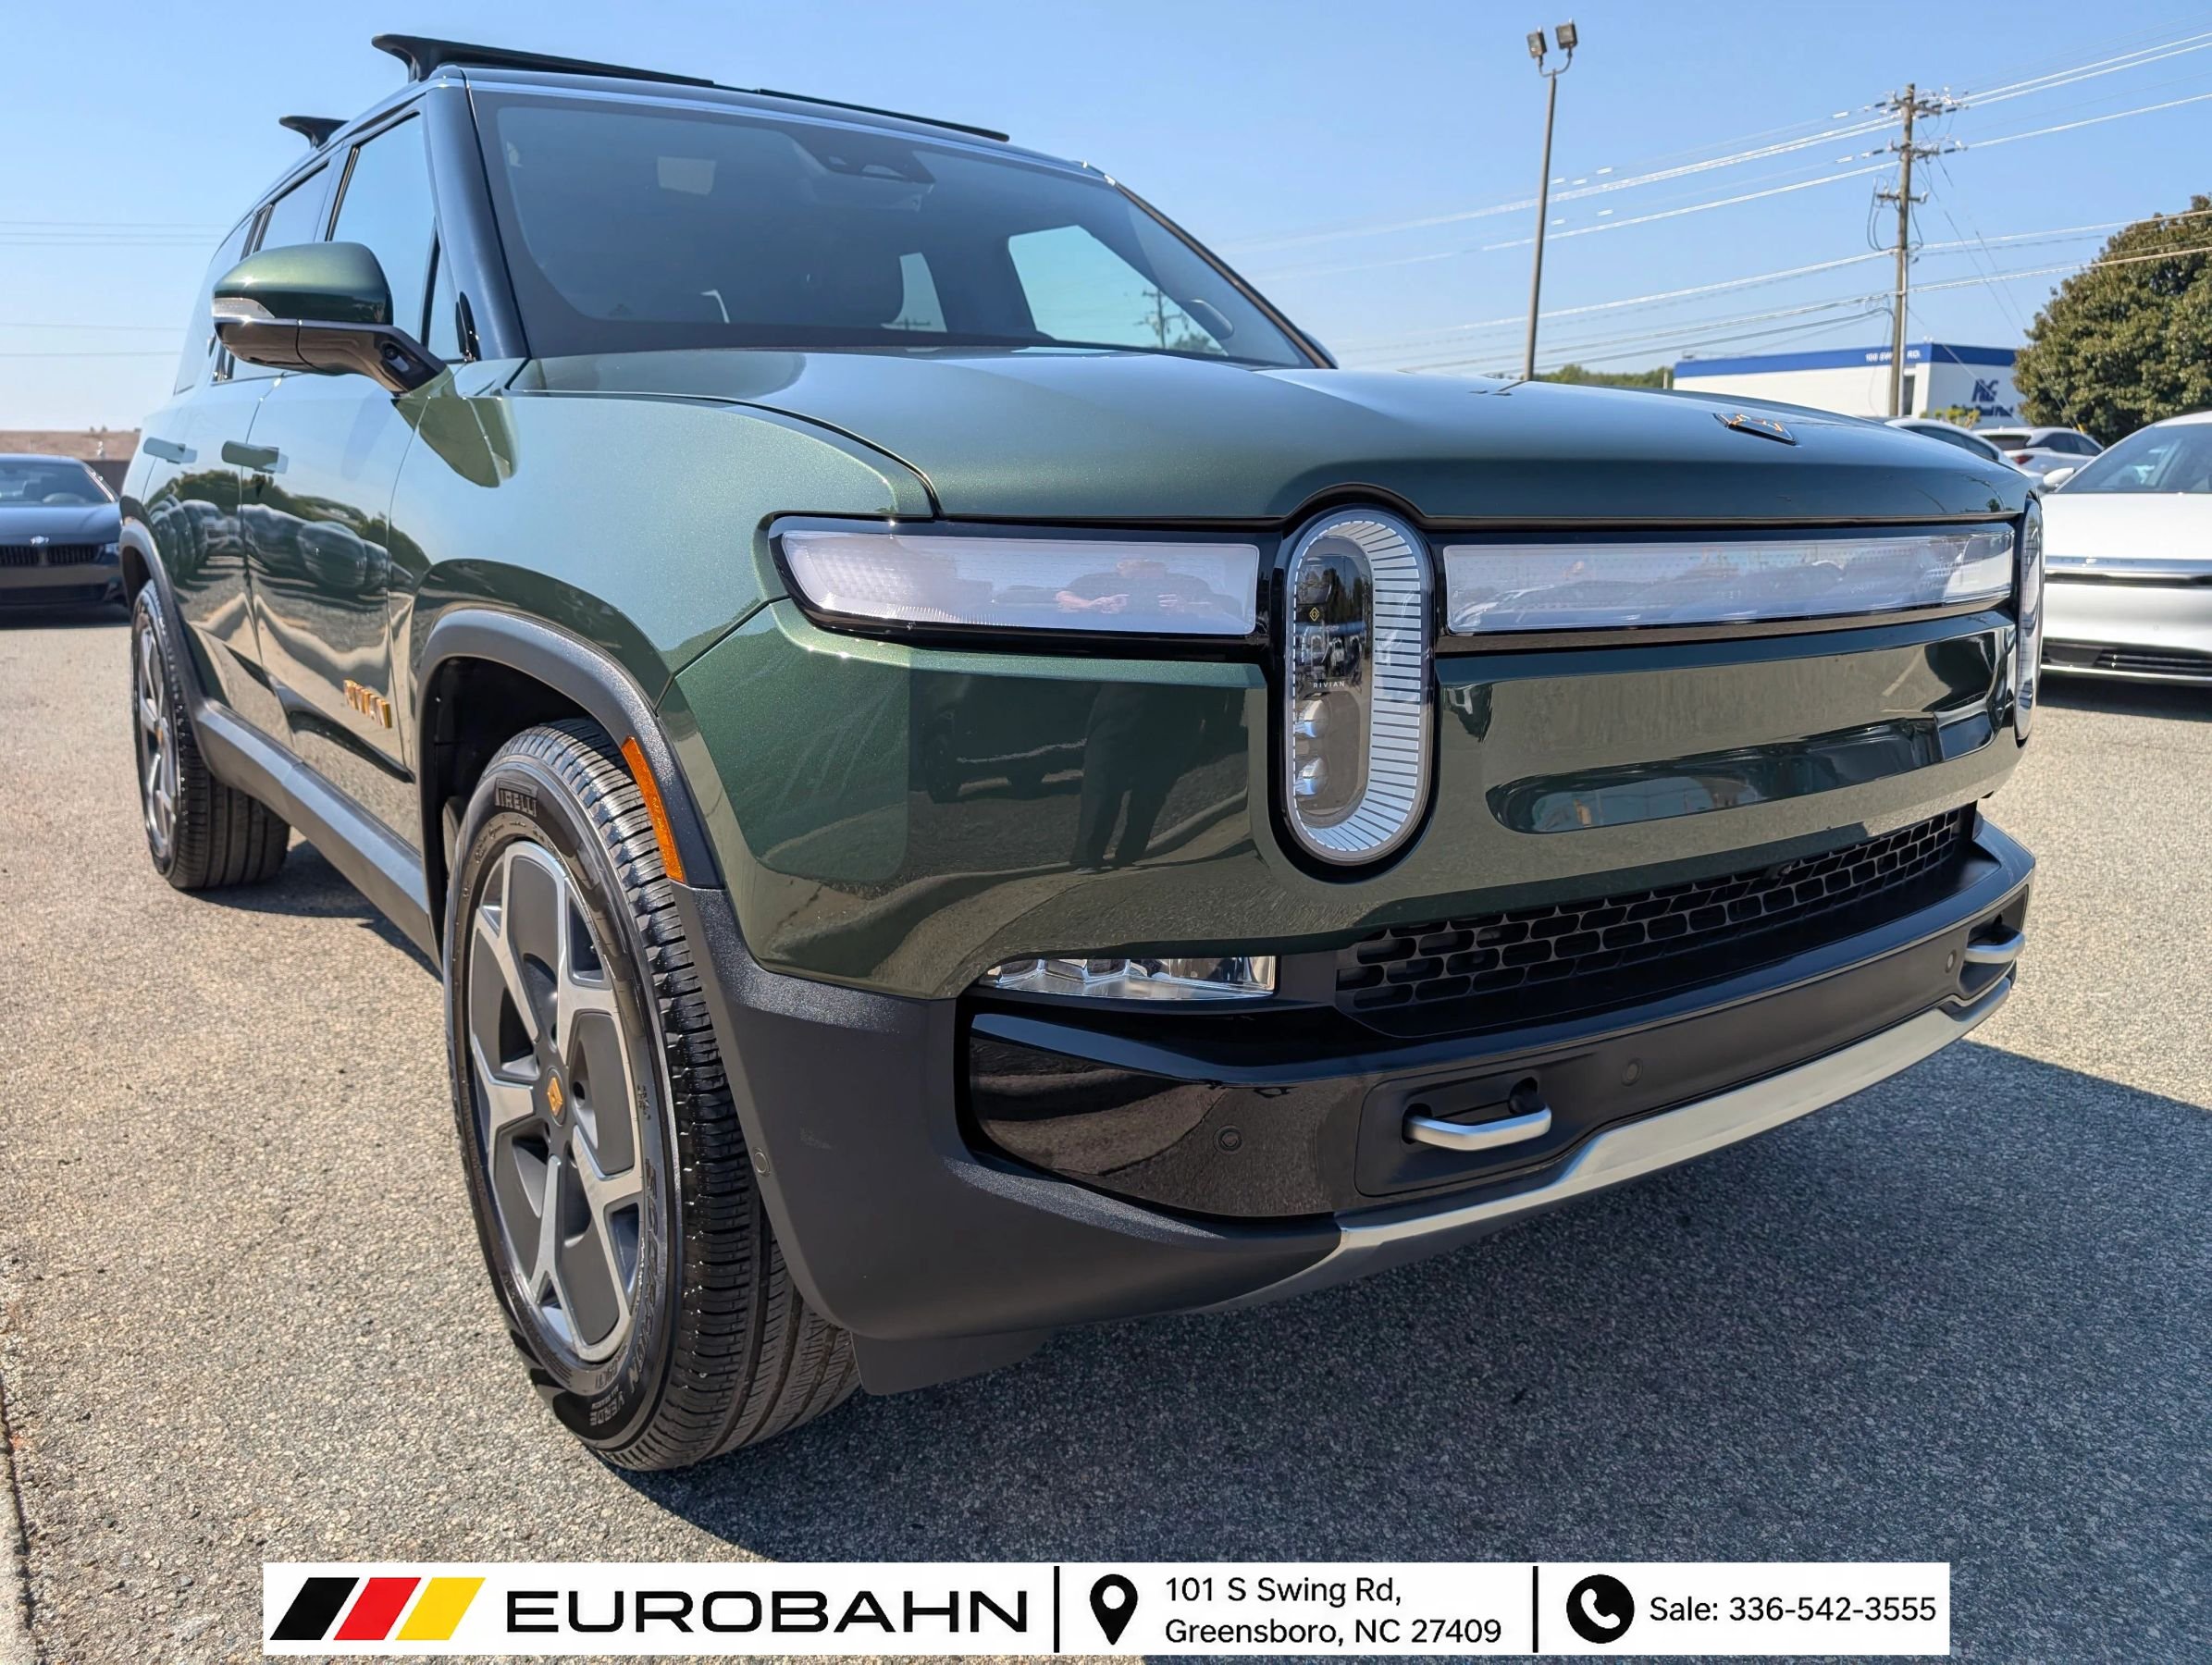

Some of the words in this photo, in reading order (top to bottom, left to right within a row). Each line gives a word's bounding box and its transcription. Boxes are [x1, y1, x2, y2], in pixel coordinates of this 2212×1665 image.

[1313, 681, 1345, 689] RIVIAN
[495, 778, 538, 817] PIRELLI
[628, 1159, 659, 1393] SCORPION
[589, 1391, 625, 1426] VERDE
